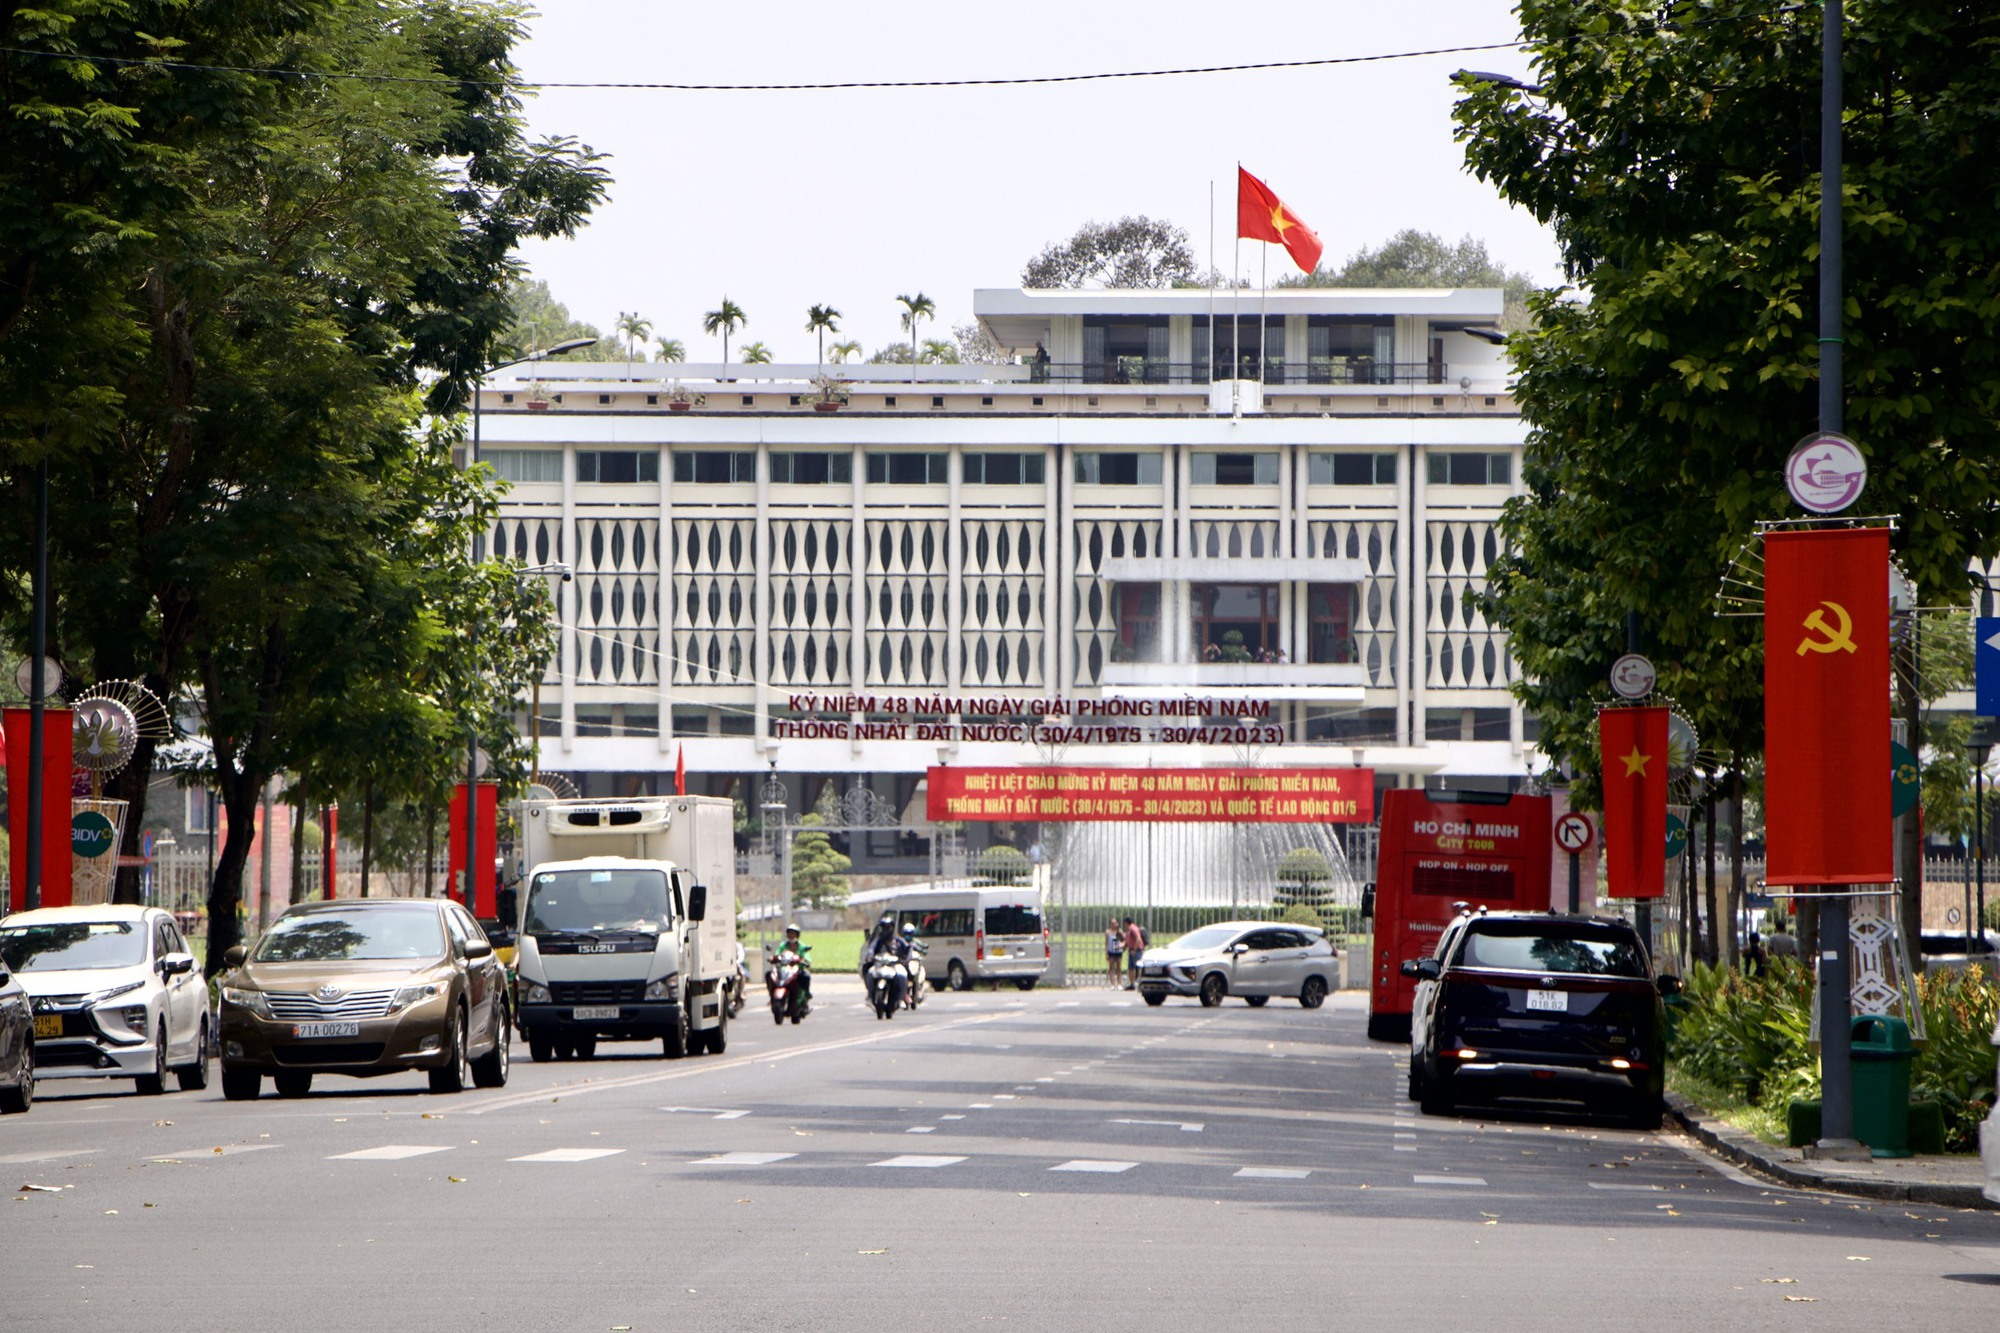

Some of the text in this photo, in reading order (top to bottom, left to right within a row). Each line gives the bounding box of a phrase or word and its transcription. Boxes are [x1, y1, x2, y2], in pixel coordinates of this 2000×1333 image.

[789, 691, 817, 711] KỶ
[882, 697, 908, 713] 48
[915, 693, 962, 714] NĂM
[969, 694, 1024, 715] NGÀY
[1031, 694, 1071, 715] GIẢI
[1159, 692, 1212, 716] MIỀN
[1220, 700, 1270, 717] NAM
[1031, 725, 1141, 744] (30/4/1975
[1162, 724, 1284, 745] 30/4/2023)
[965, 771, 1341, 794] NHIỆT LIỆT CHÀO MỪNG KỶ NIỆM 48 NĂM NGÀY GIẢI PHÓNG MIỀN NAM,
[947, 794, 982, 813] THỐNG
[984, 794, 1013, 813] NHẤT
[1016, 794, 1038, 814] ĐẤT
[1041, 796, 1070, 814] NƯỚC
[1073, 799, 1133, 816] (30/4/1975
[1144, 799, 1207, 816] 30/4/2023)
[1210, 797, 1224, 815] VÀ
[1228, 796, 1257, 816] QUỐC
[1260, 796, 1275, 815] TẾ
[1276, 800, 1297, 815] LAO
[1301, 797, 1330, 818] ĐỘNG
[1333, 800, 1357, 817] 01/5
[1414, 820, 1439, 834] HO
[1475, 824, 1519, 838] MINH
[1419, 860, 1440, 869] HOP
[1443, 861, 1458, 870] ON
[1466, 862, 1487, 871] HOP
[1490, 864, 1509, 872] OFF
[578, 944, 616, 953] ISUZU
